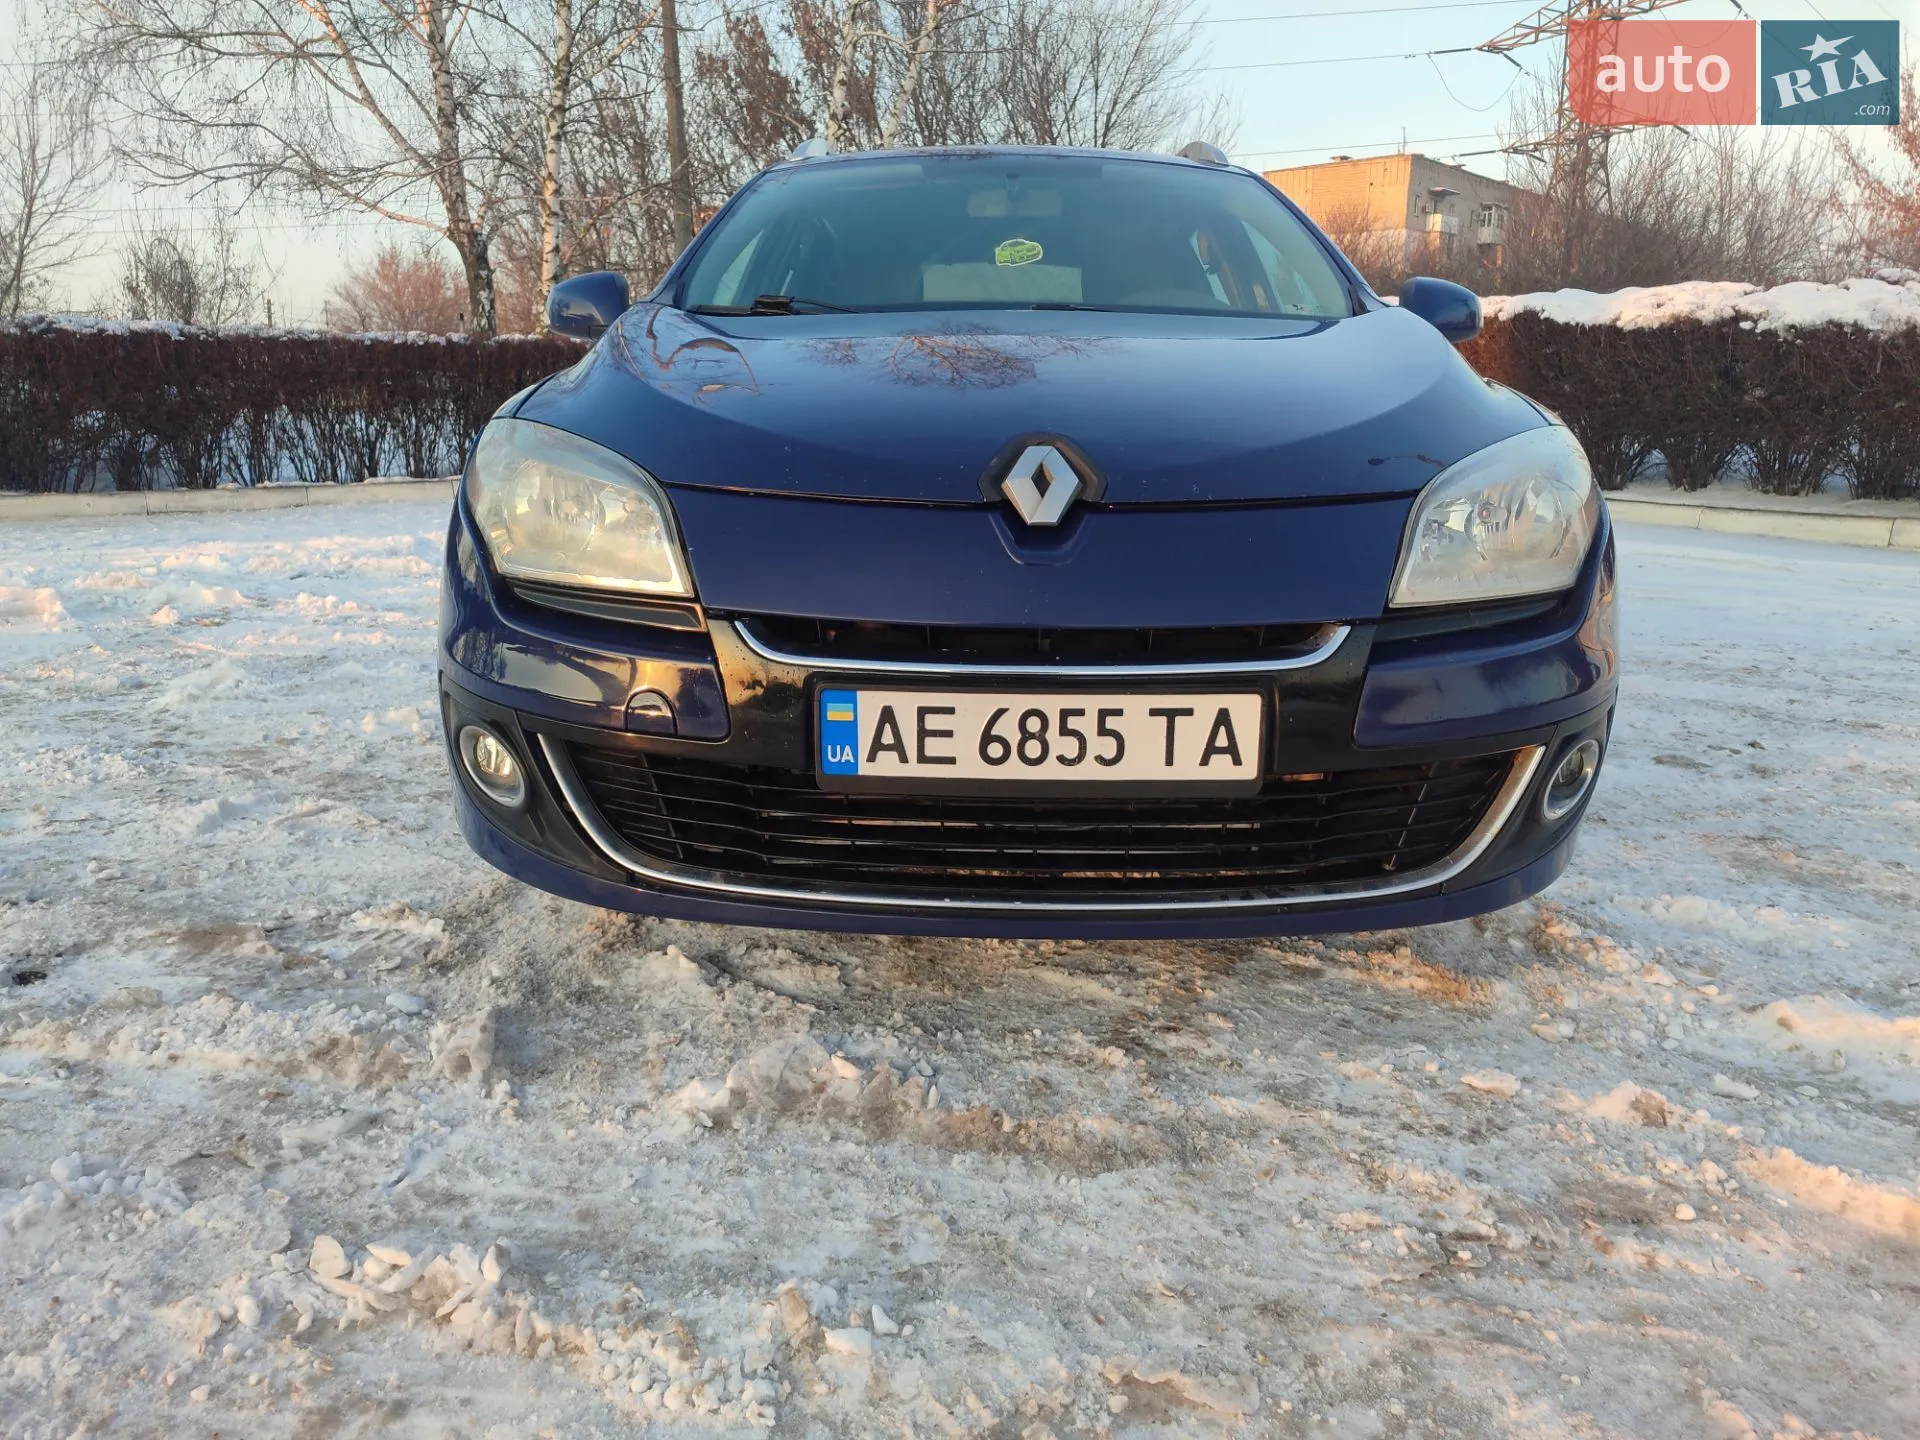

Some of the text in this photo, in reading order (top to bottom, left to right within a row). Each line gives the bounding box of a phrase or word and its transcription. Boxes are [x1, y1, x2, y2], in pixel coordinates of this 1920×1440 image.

[827, 744, 855, 764] UA
[865, 705, 1243, 767] AE 6855 TA
